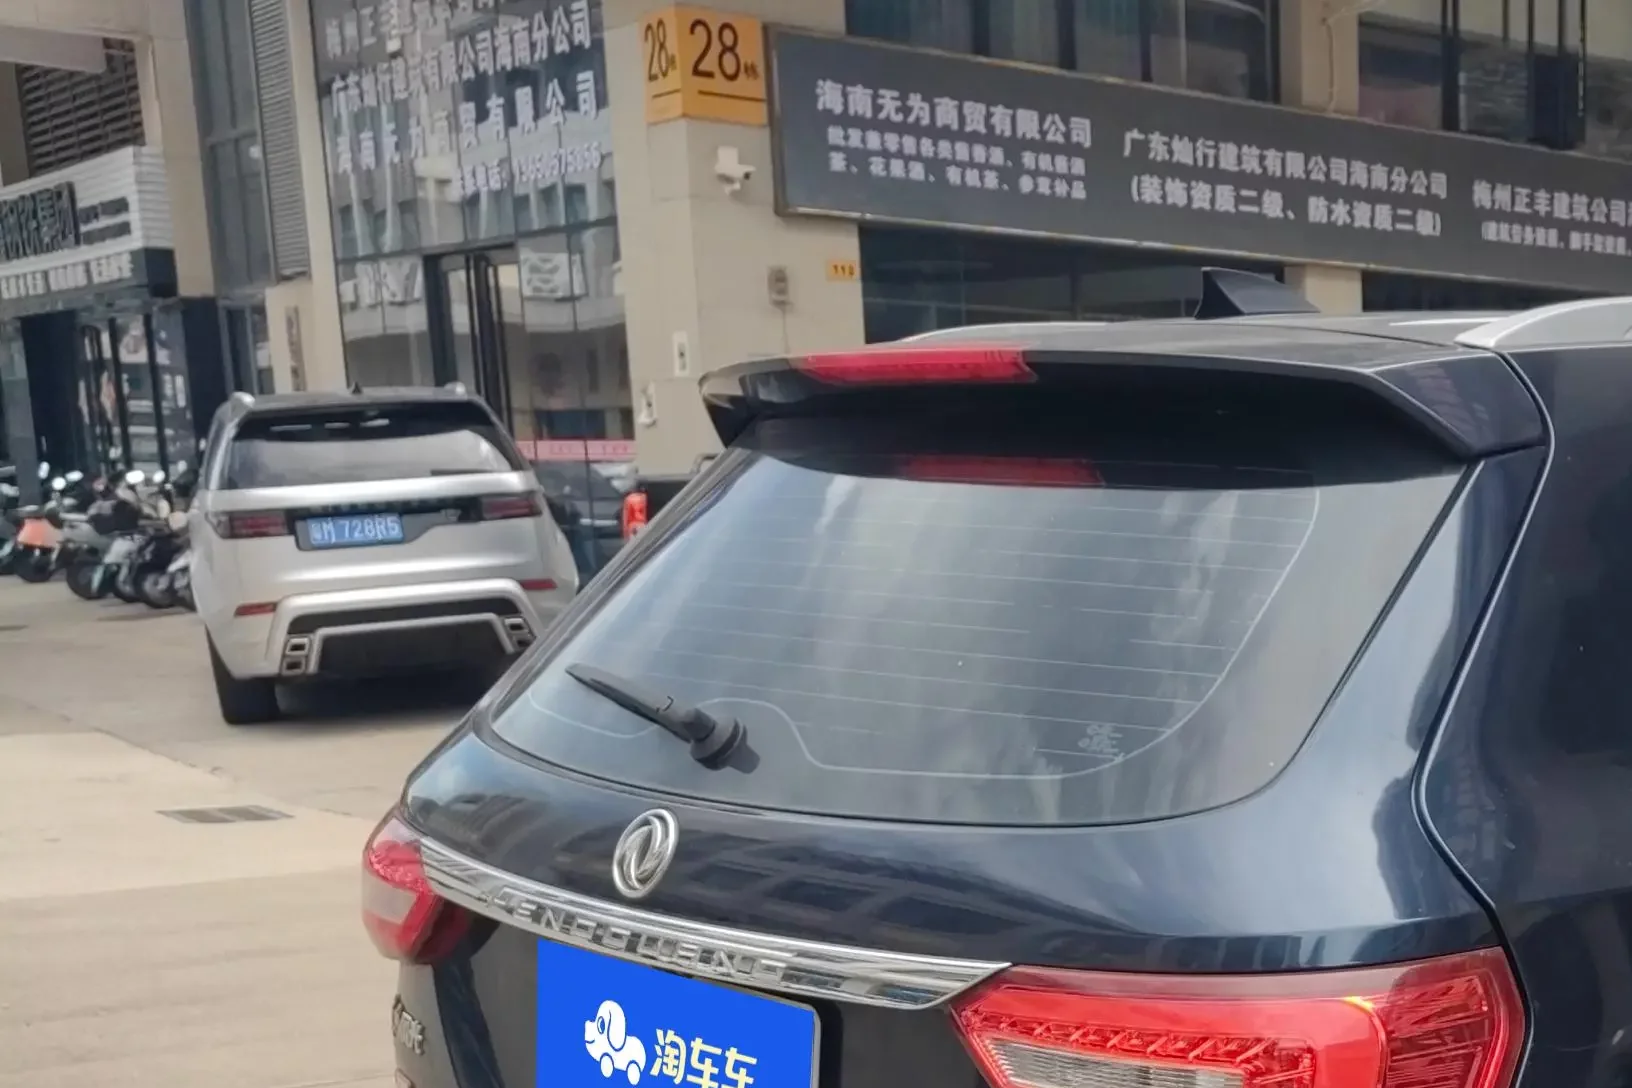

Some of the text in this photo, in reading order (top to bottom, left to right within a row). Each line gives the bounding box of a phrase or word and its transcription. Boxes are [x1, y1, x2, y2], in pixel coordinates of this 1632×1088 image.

[816, 79, 1091, 147] 海南无为商贸有限公司
